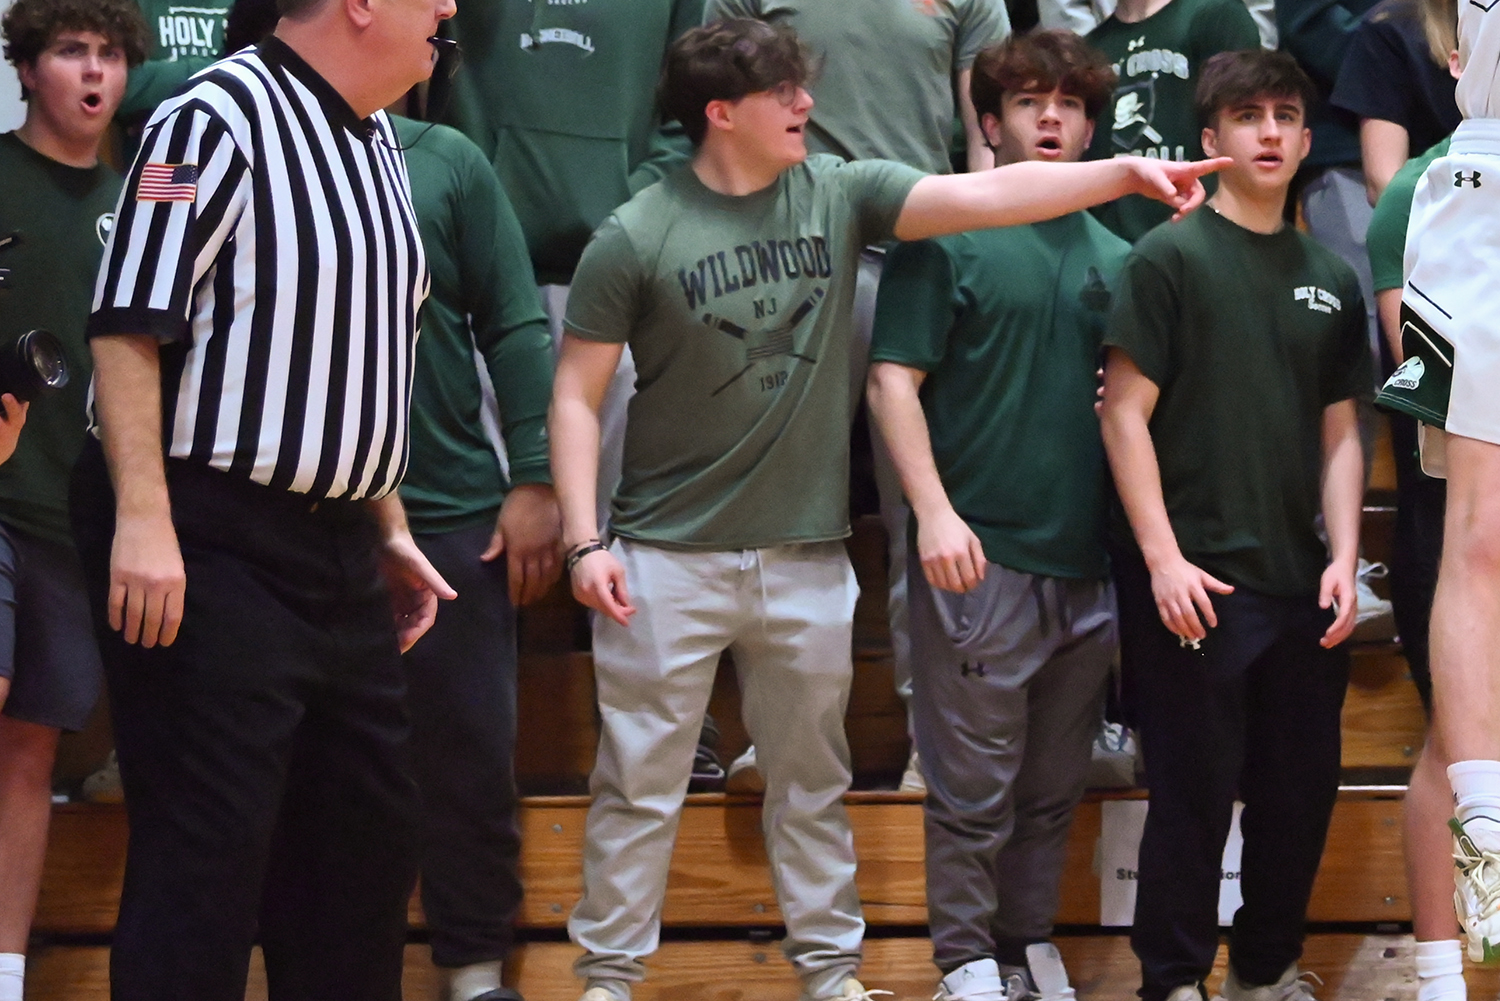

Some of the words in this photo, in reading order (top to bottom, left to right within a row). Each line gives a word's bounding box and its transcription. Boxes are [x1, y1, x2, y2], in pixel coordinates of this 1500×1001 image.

[158, 15, 215, 49] HOLY
[677, 235, 833, 310] WILDWOOD
[752, 297, 778, 319] NJ
